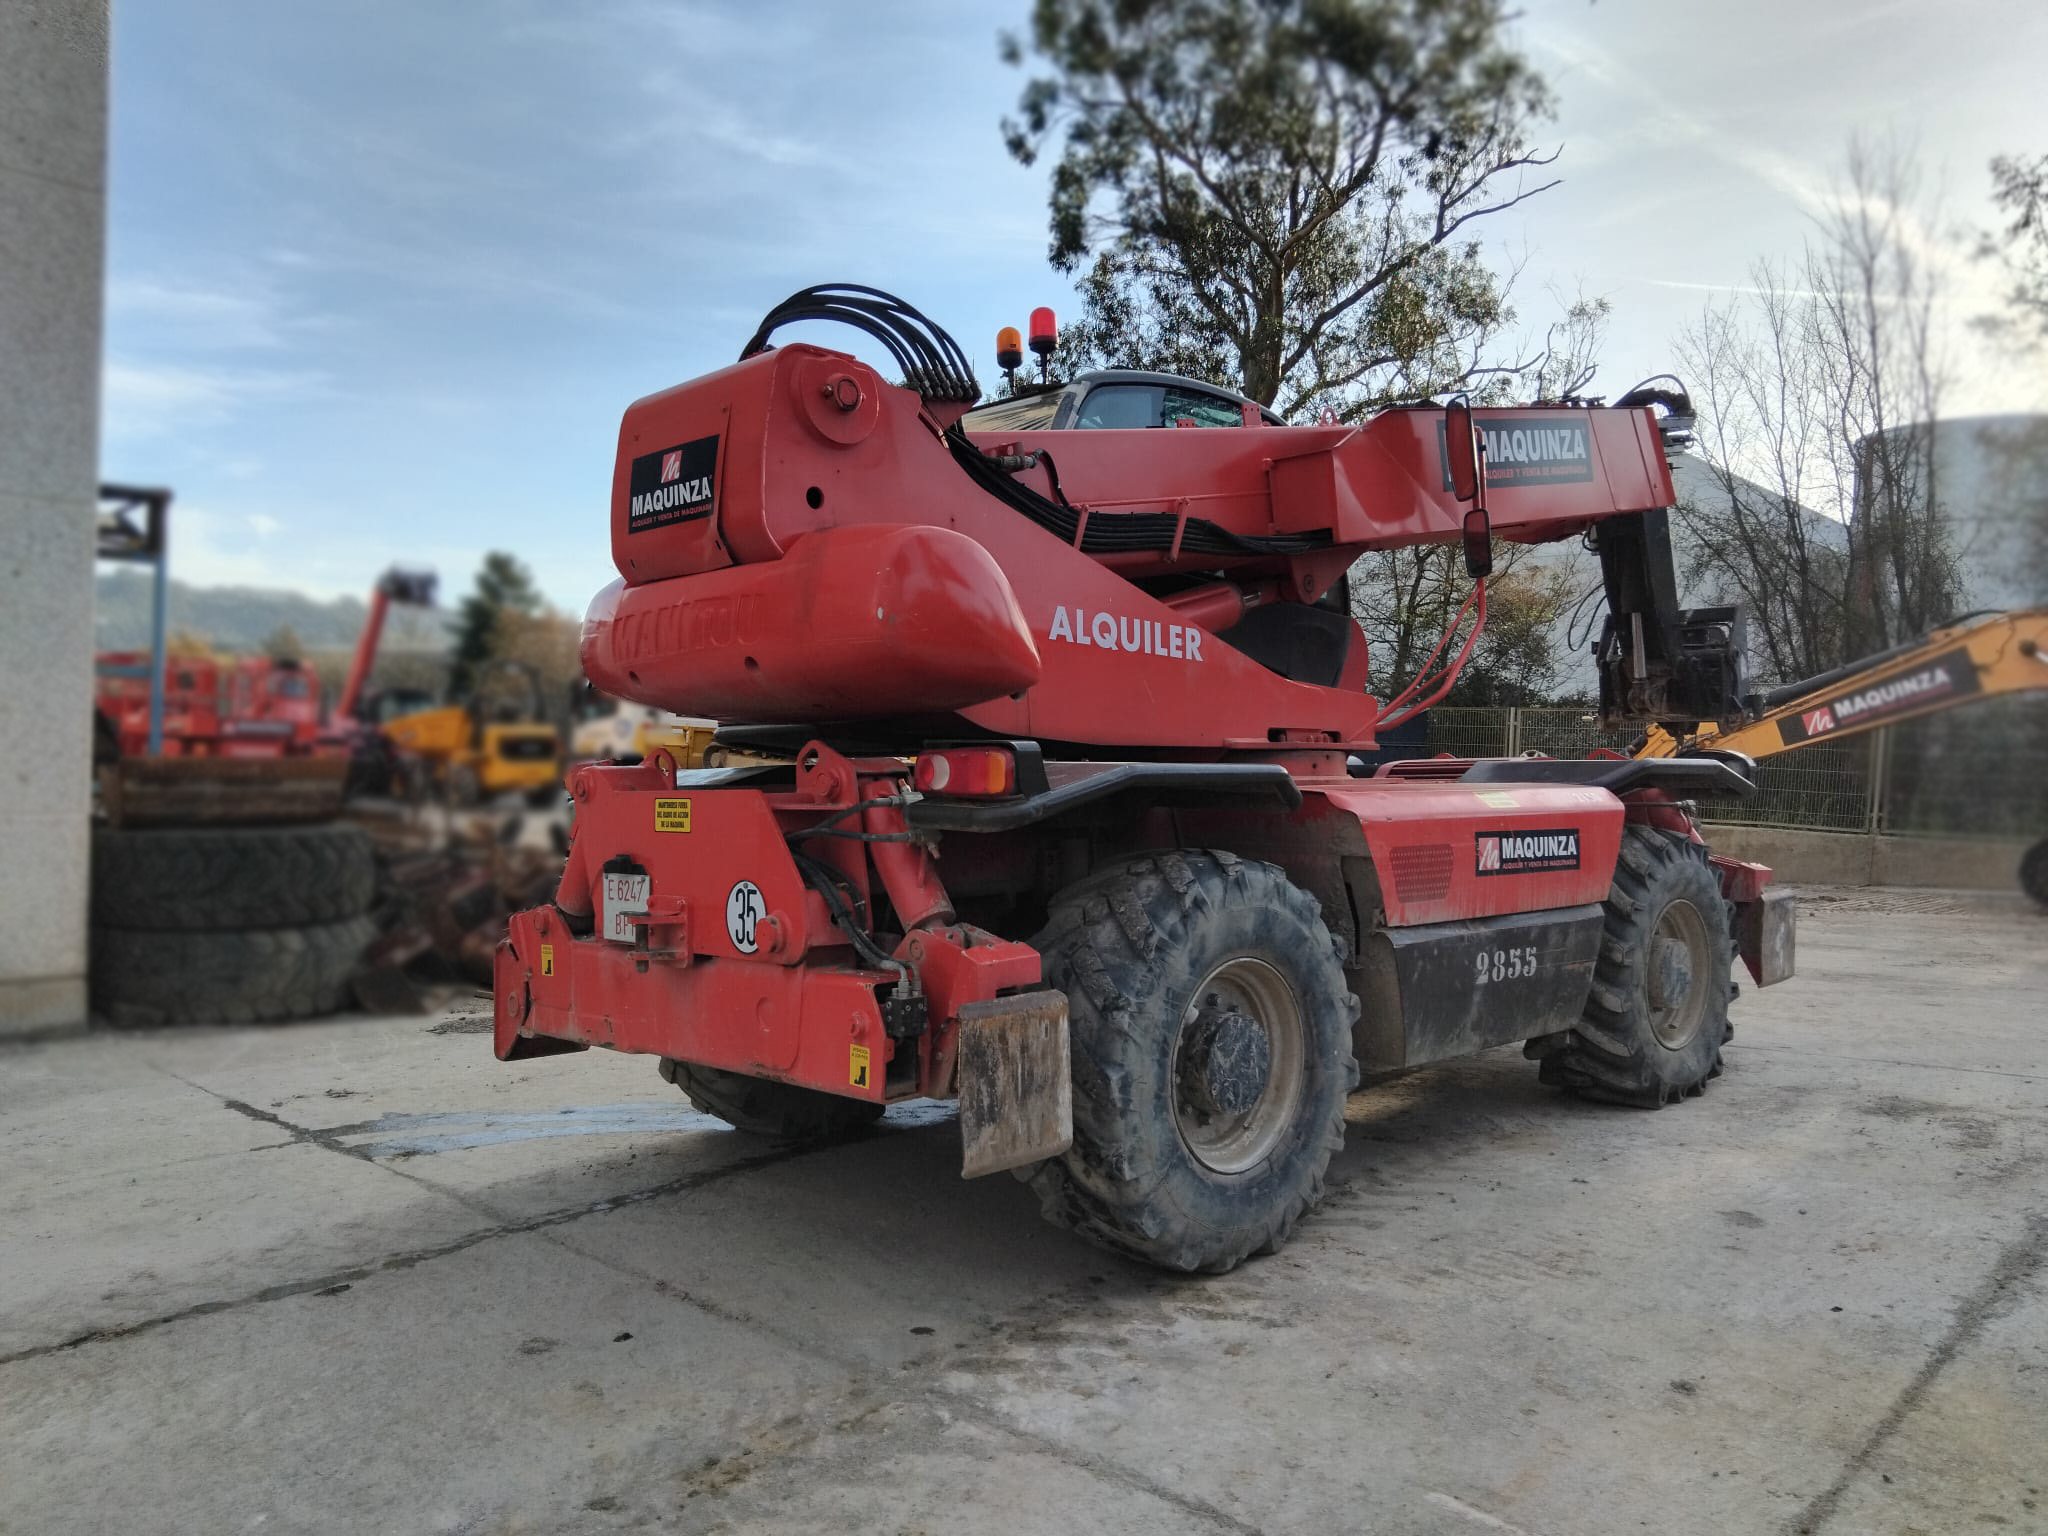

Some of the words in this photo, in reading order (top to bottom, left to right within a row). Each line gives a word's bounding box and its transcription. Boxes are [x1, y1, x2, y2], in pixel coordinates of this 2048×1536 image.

[1484, 429, 1586, 463] MAQUINZA
[632, 477, 712, 517] MAQUINZA
[1048, 605, 1204, 662] ALQUILER
[1834, 667, 1950, 719] MAQUINZA
[1502, 835, 1577, 859] MAQUINZA
[608, 879, 614, 900] E
[618, 879, 645, 902] 6247
[735, 888, 757, 945] 35
[1475, 947, 1537, 985] 2855
